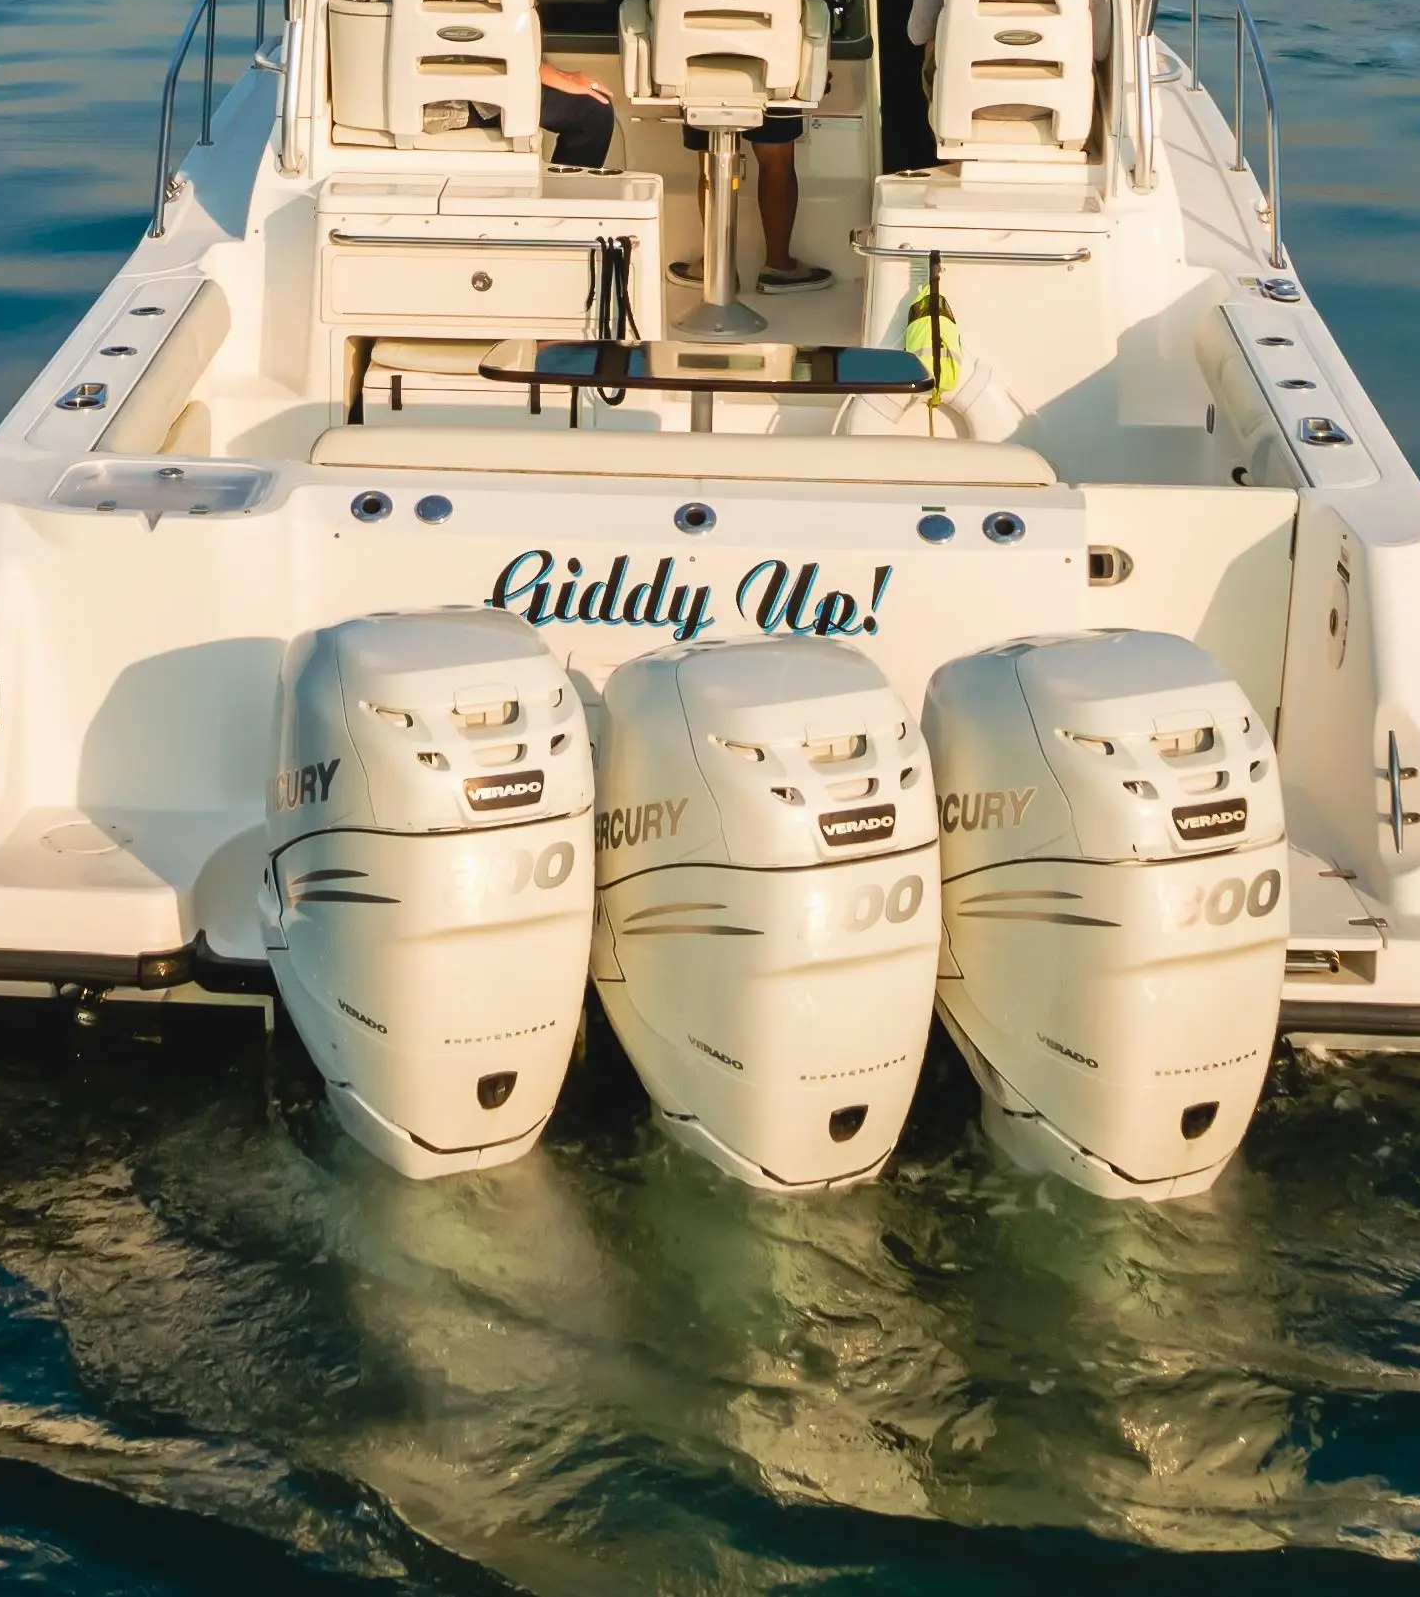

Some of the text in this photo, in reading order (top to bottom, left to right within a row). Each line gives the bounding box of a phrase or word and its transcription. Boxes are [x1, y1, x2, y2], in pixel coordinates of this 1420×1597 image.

[483, 549, 893, 641] Giddy Up!
[467, 781, 542, 800] VERADO
[823, 816, 894, 836] VERADO
[1176, 810, 1246, 830] VERADO
[337, 998, 388, 1035] VERADO
[687, 1033, 744, 1071] VERADO
[1036, 1031, 1097, 1069] VERADO
